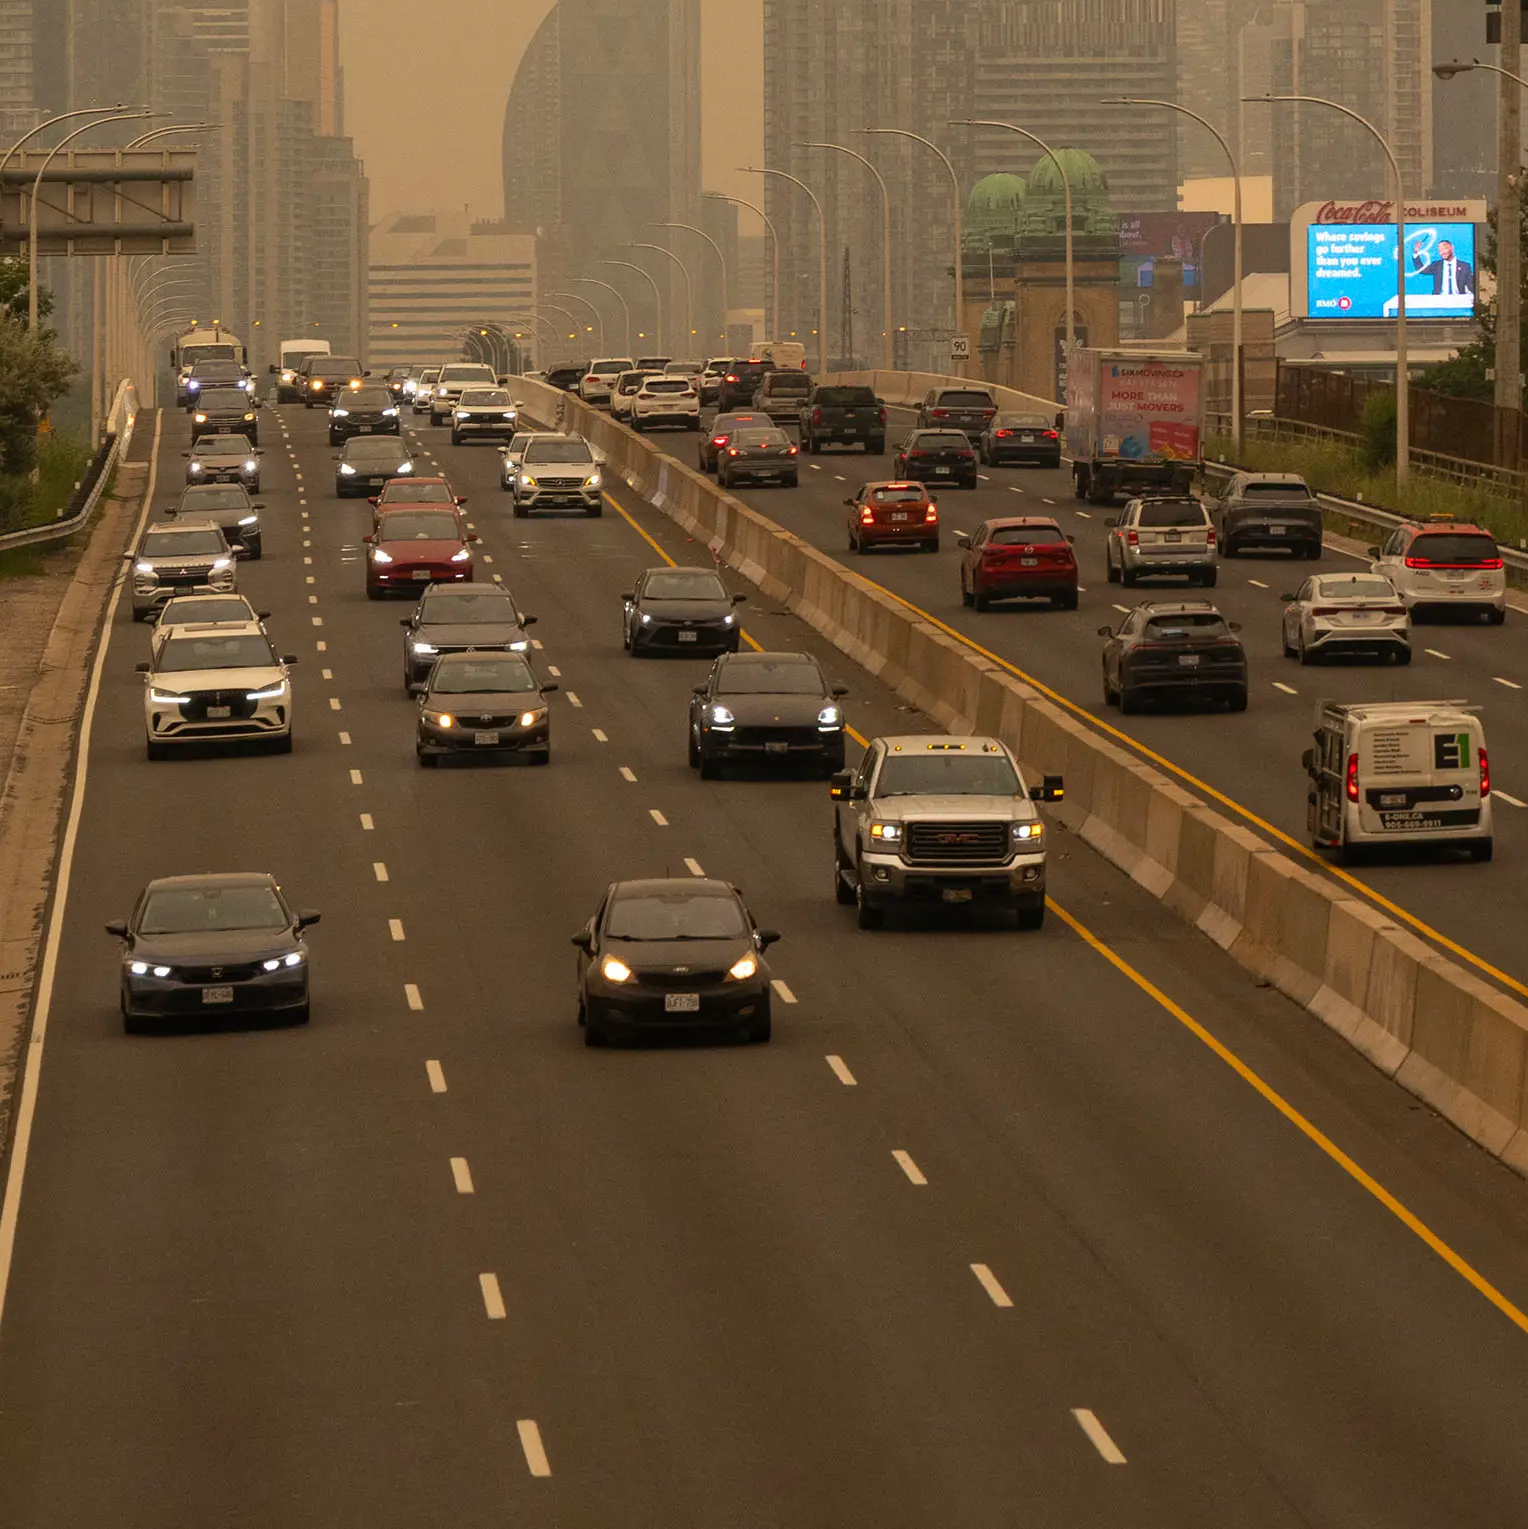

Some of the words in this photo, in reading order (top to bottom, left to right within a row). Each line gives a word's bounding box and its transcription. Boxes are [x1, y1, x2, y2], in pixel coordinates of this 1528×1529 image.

[1316, 201, 1396, 224] Coca-Cola
[1315, 231, 1347, 242] Where
[1349, 232, 1385, 244] savings
[1316, 246, 1329, 257] go
[1316, 256, 1339, 266] than
[1340, 257, 1358, 268] you
[1360, 257, 1382, 266] ever
[953, 341, 966, 352] 90
[1112, 392, 1144, 400] MORE
[1146, 392, 1178, 401] THAN
[1137, 403, 1184, 412] MOVERS
